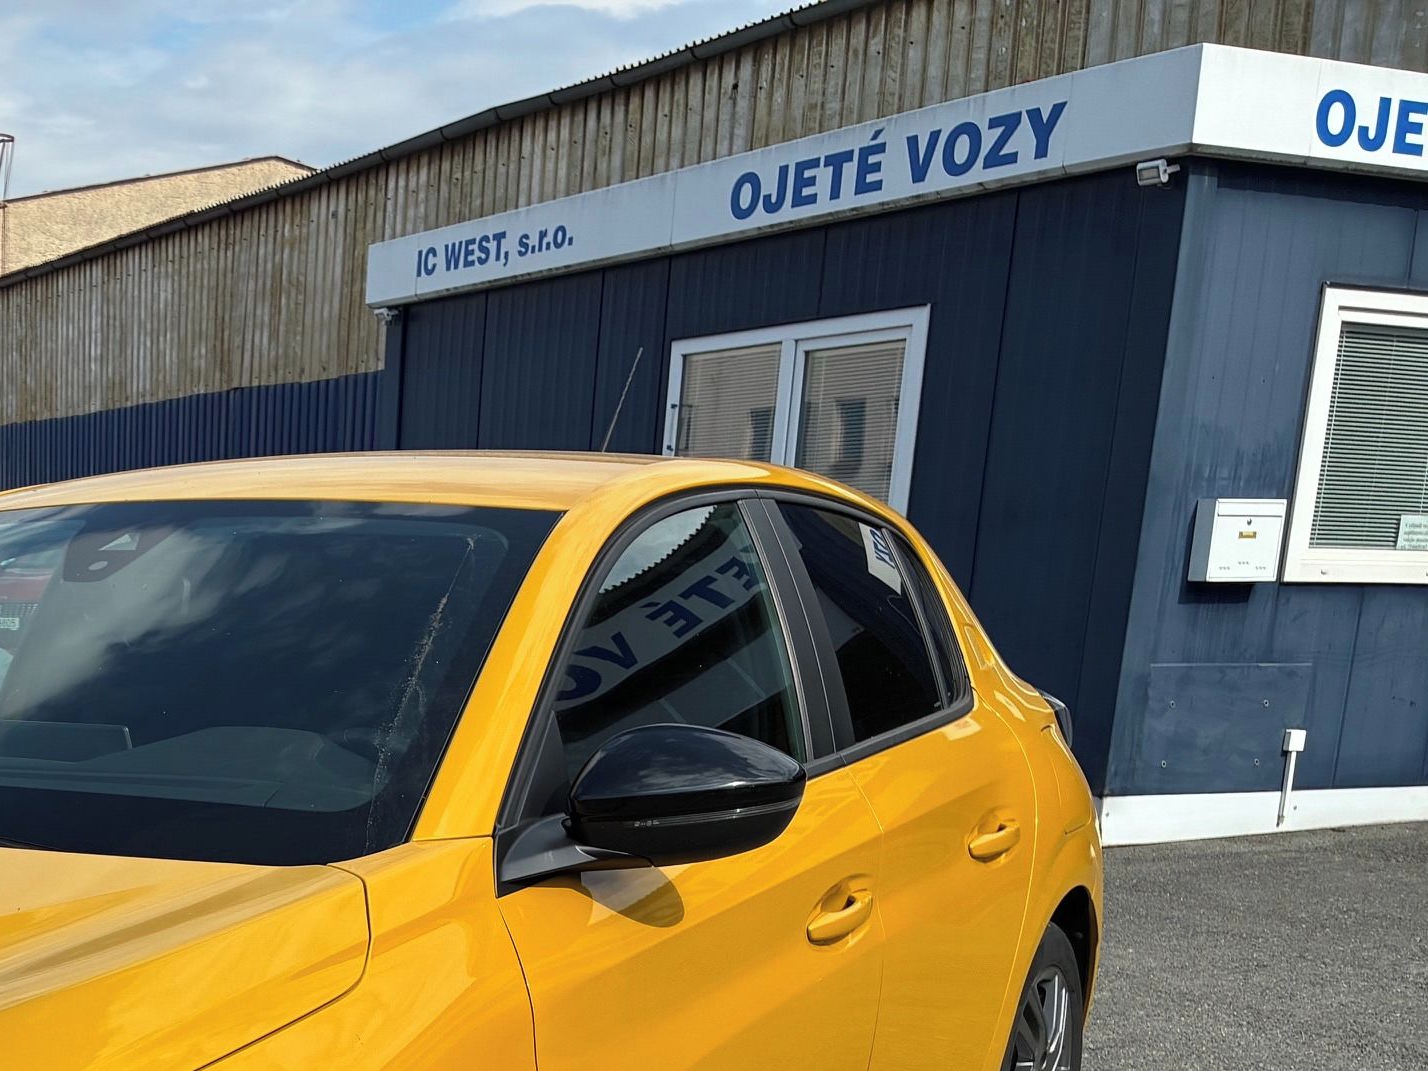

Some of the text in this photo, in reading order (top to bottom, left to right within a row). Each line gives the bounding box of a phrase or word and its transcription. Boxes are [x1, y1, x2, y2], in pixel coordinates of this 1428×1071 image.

[1316, 89, 1428, 157] OJE
[730, 101, 1068, 220] OJETÉ VOZY
[416, 225, 574, 277] IC WEST, s.r.o.
